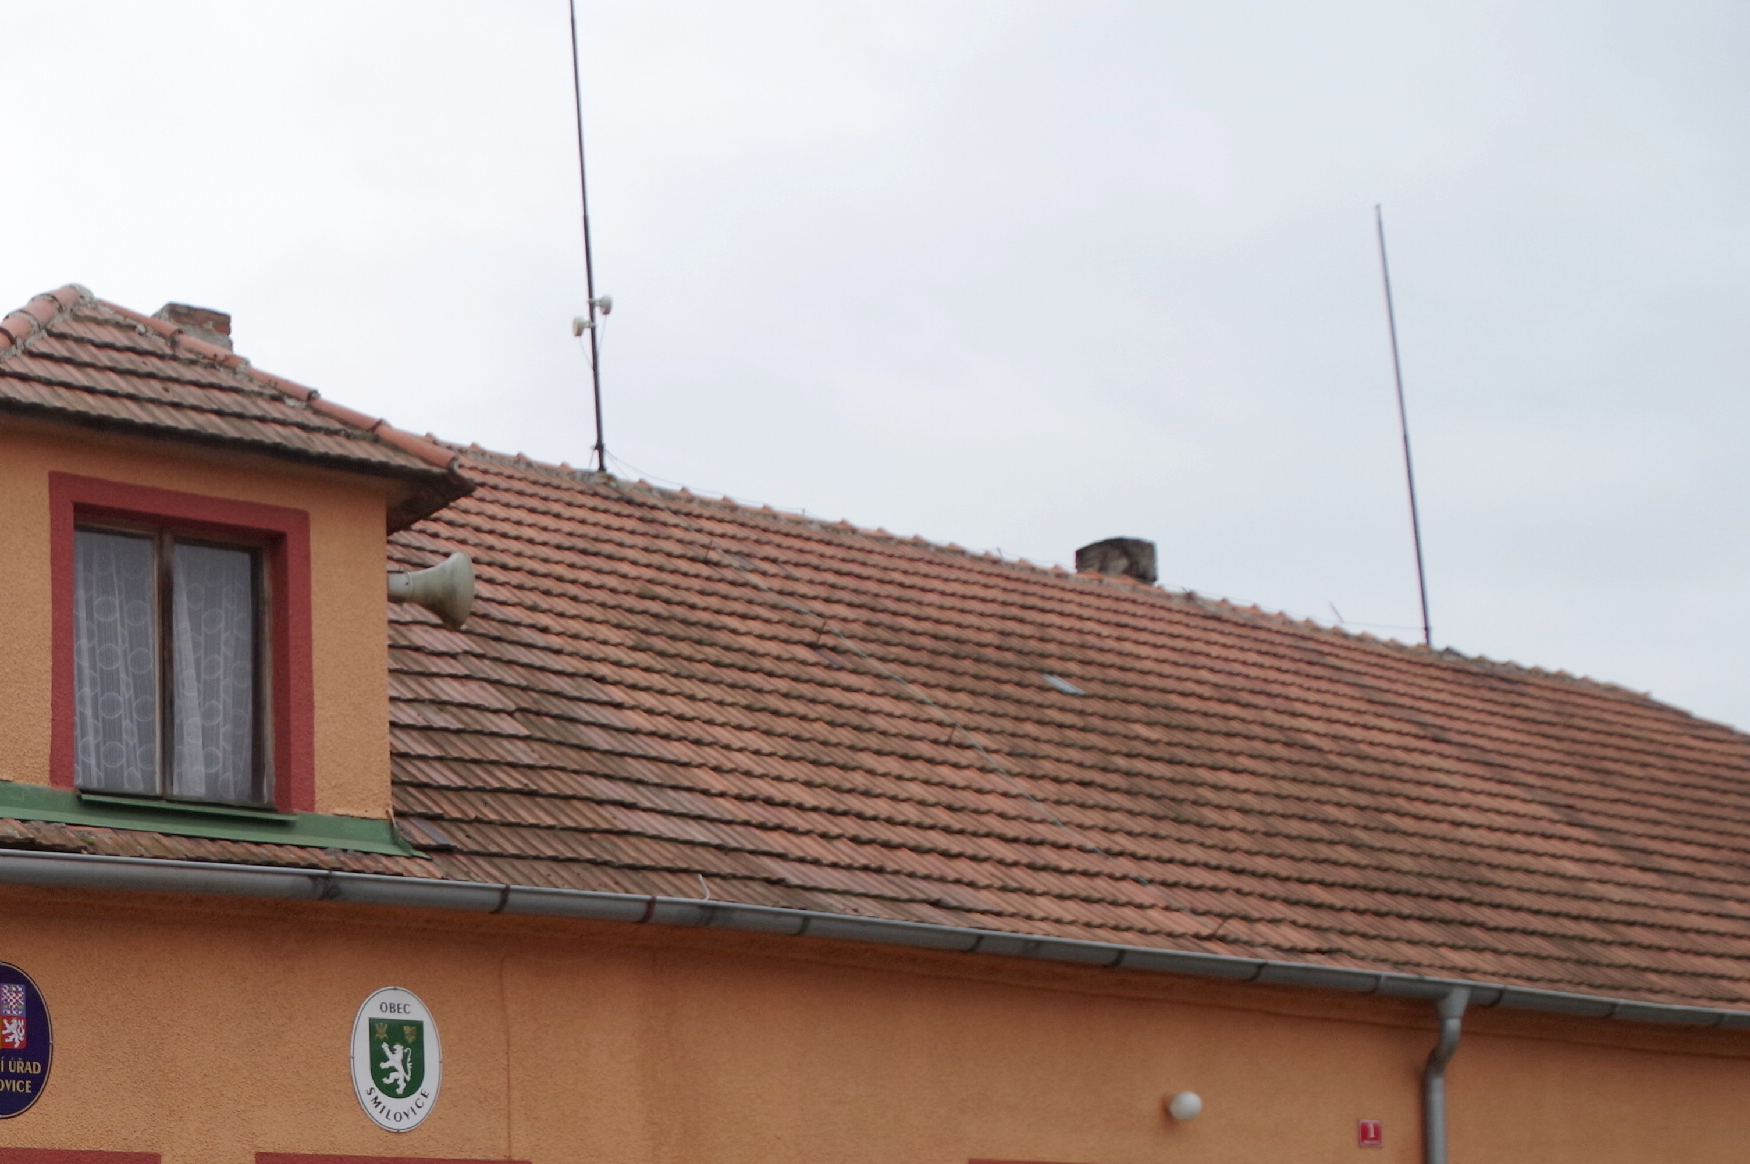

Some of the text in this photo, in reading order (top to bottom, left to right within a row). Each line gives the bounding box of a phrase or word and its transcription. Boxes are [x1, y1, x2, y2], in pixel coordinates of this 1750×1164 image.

[379, 1001, 411, 1014] OBEC
[8, 1057, 42, 1074] ÚŘAD
[366, 1086, 430, 1122] SMILOVICE
